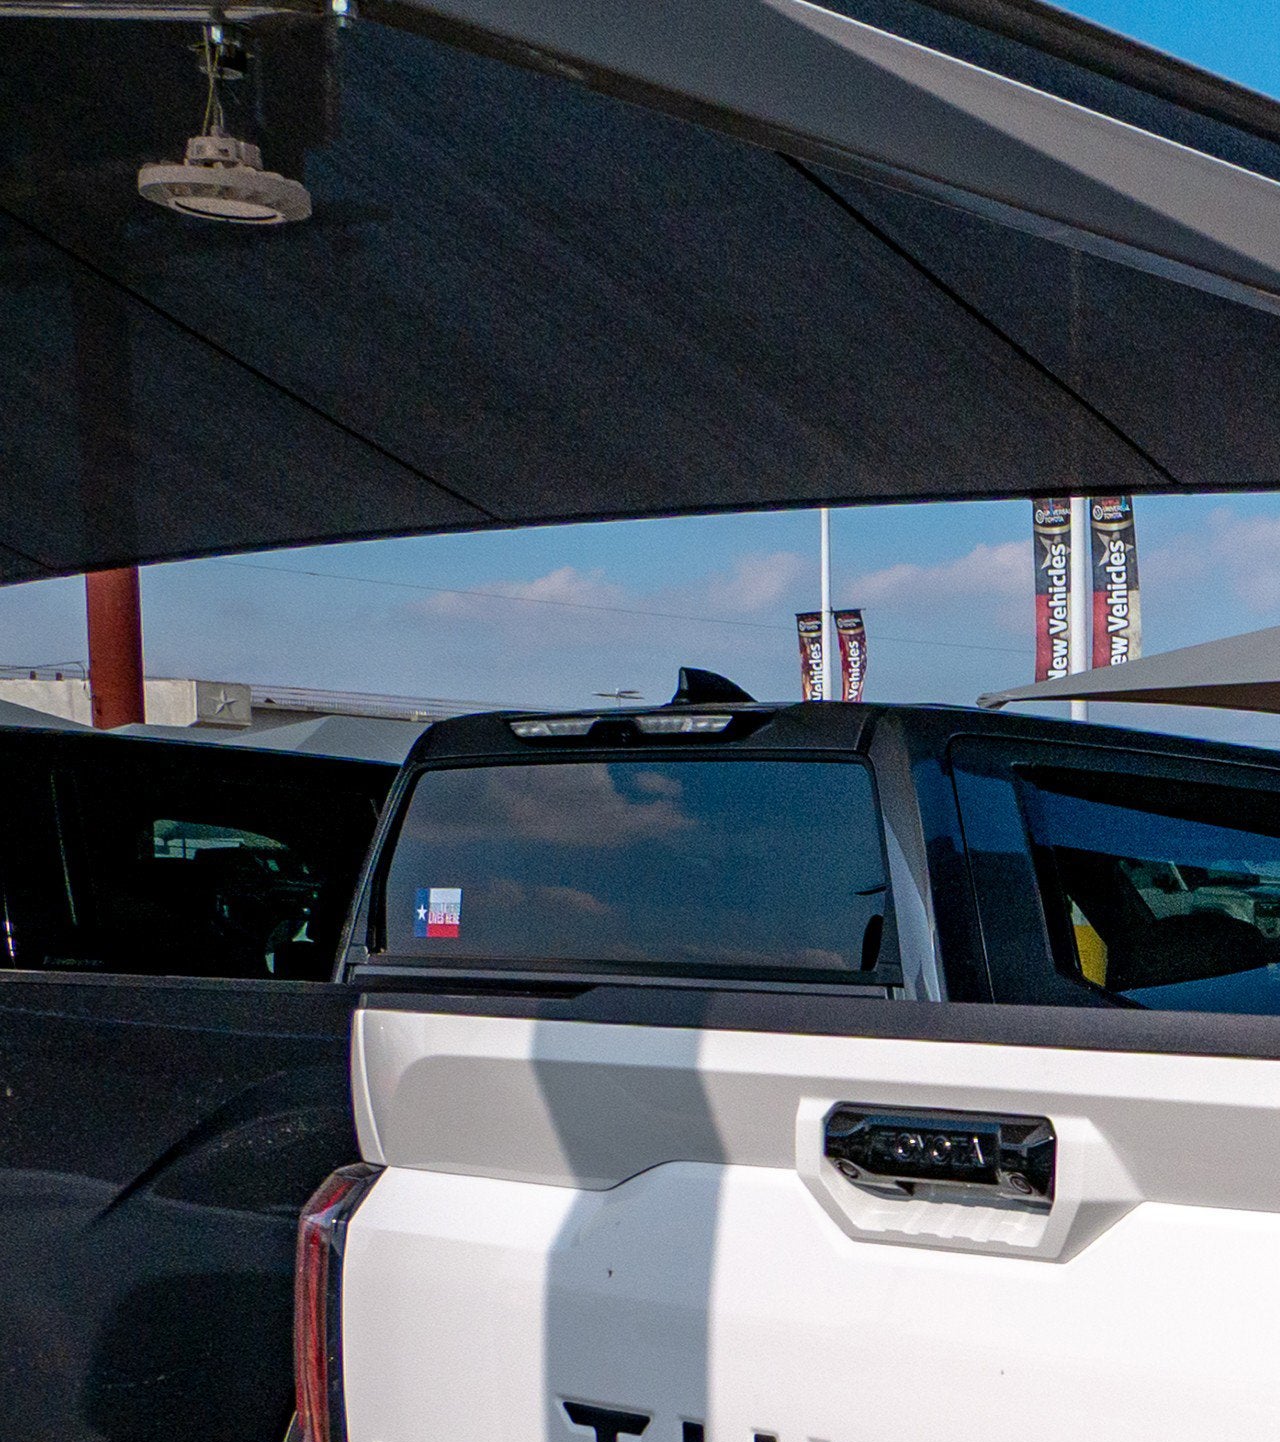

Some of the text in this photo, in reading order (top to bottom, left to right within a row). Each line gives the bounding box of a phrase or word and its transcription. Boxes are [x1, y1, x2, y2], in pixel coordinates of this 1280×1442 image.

[1048, 543, 1069, 635] Vehicles
[1105, 540, 1129, 666] ew Vehicles
